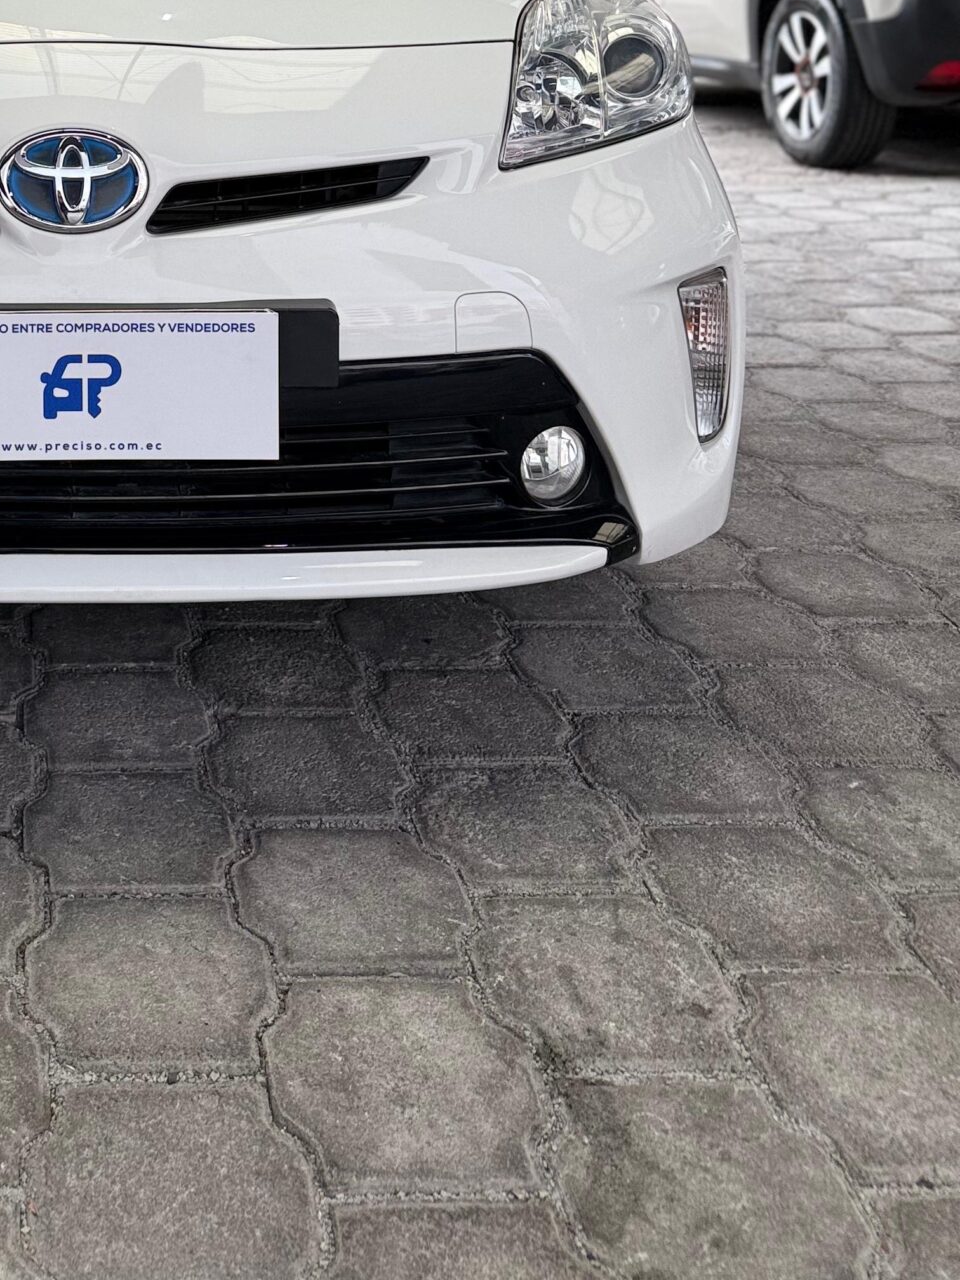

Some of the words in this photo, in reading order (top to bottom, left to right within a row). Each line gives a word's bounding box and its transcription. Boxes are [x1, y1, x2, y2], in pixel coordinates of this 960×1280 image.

[11, 323, 54, 334] ENTRE
[55, 322, 156, 334] COMPRADORES
[157, 323, 167, 334] Y
[167, 322, 256, 334] VENDEDORES
[1, 440, 163, 454] www.preciso.com.ec
